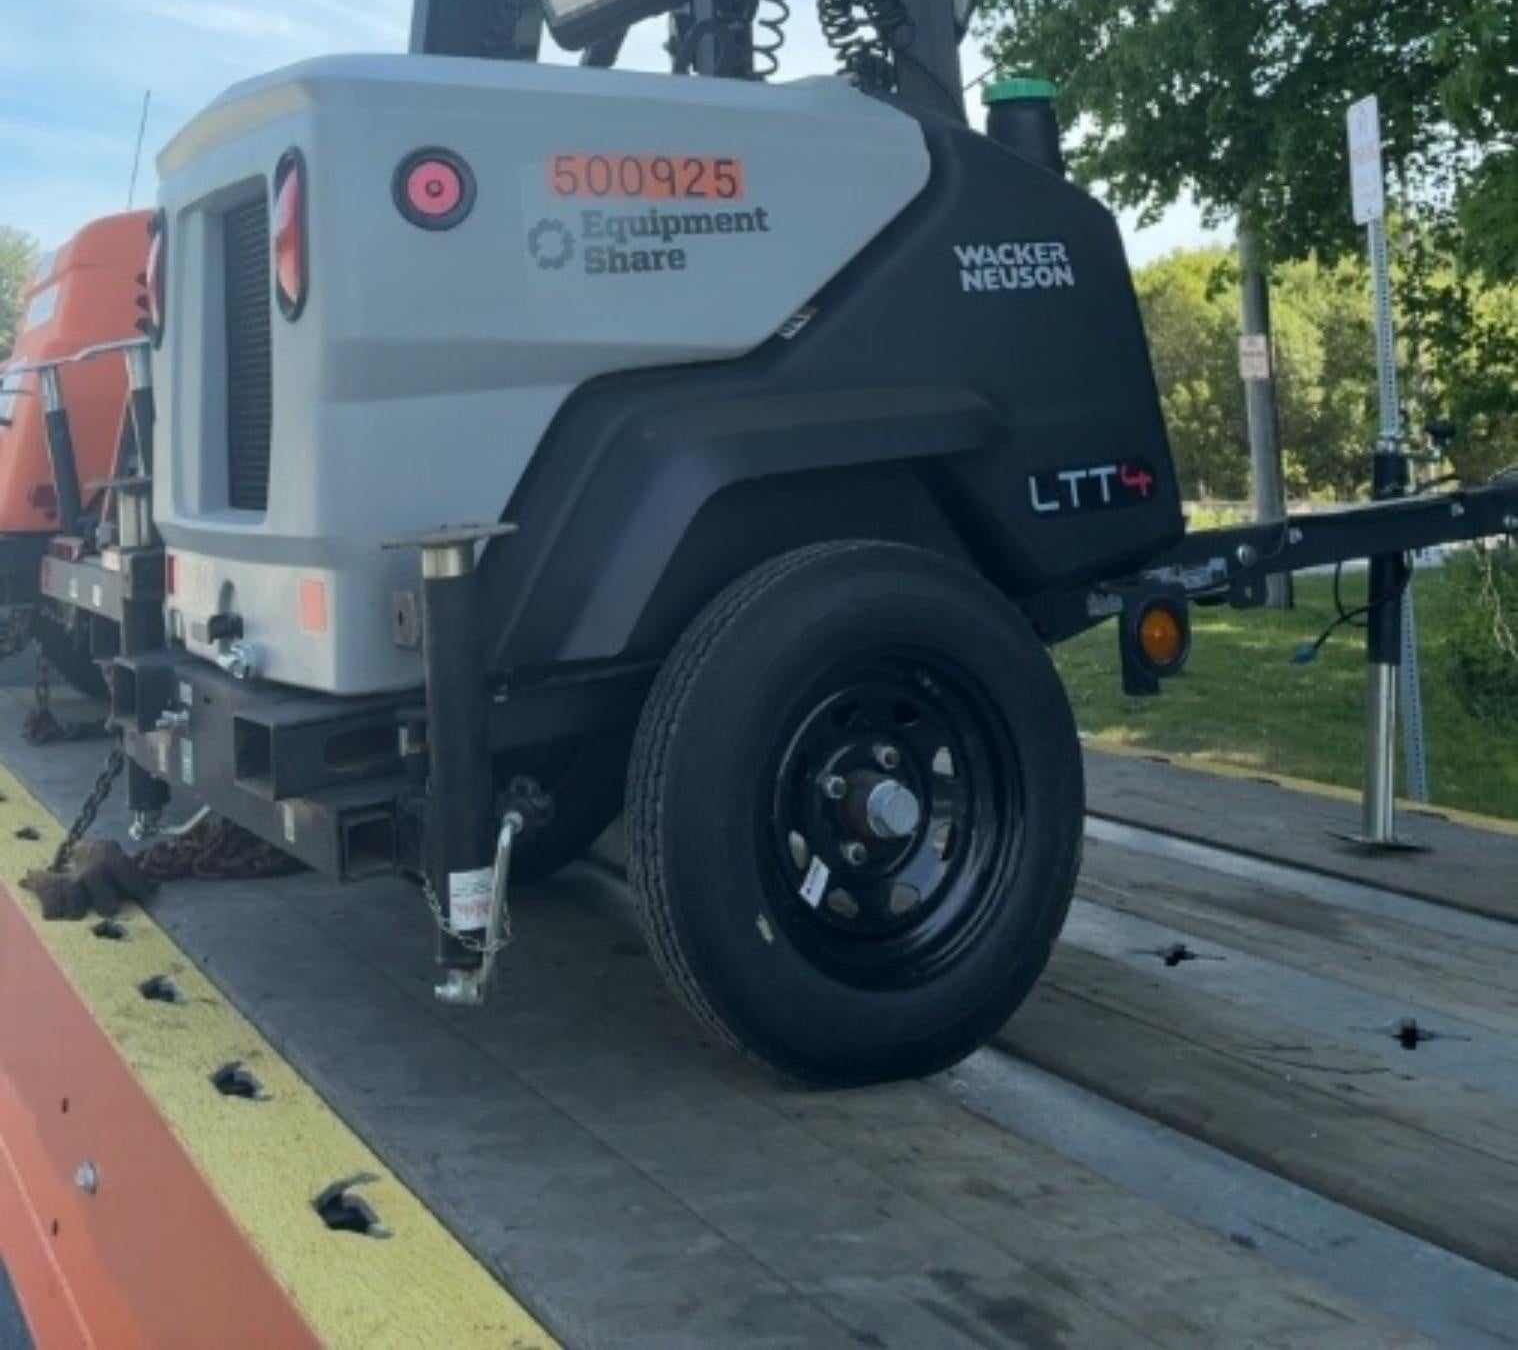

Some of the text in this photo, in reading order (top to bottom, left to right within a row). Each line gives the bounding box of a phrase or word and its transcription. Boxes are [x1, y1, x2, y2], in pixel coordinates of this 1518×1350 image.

[553, 154, 738, 199] 500925
[579, 206, 769, 244] Equipment
[583, 247, 687, 275] Share
[953, 241, 1069, 268] WACKER
[960, 263, 1075, 292] NEUSON
[1028, 463, 1153, 512] LTT4
